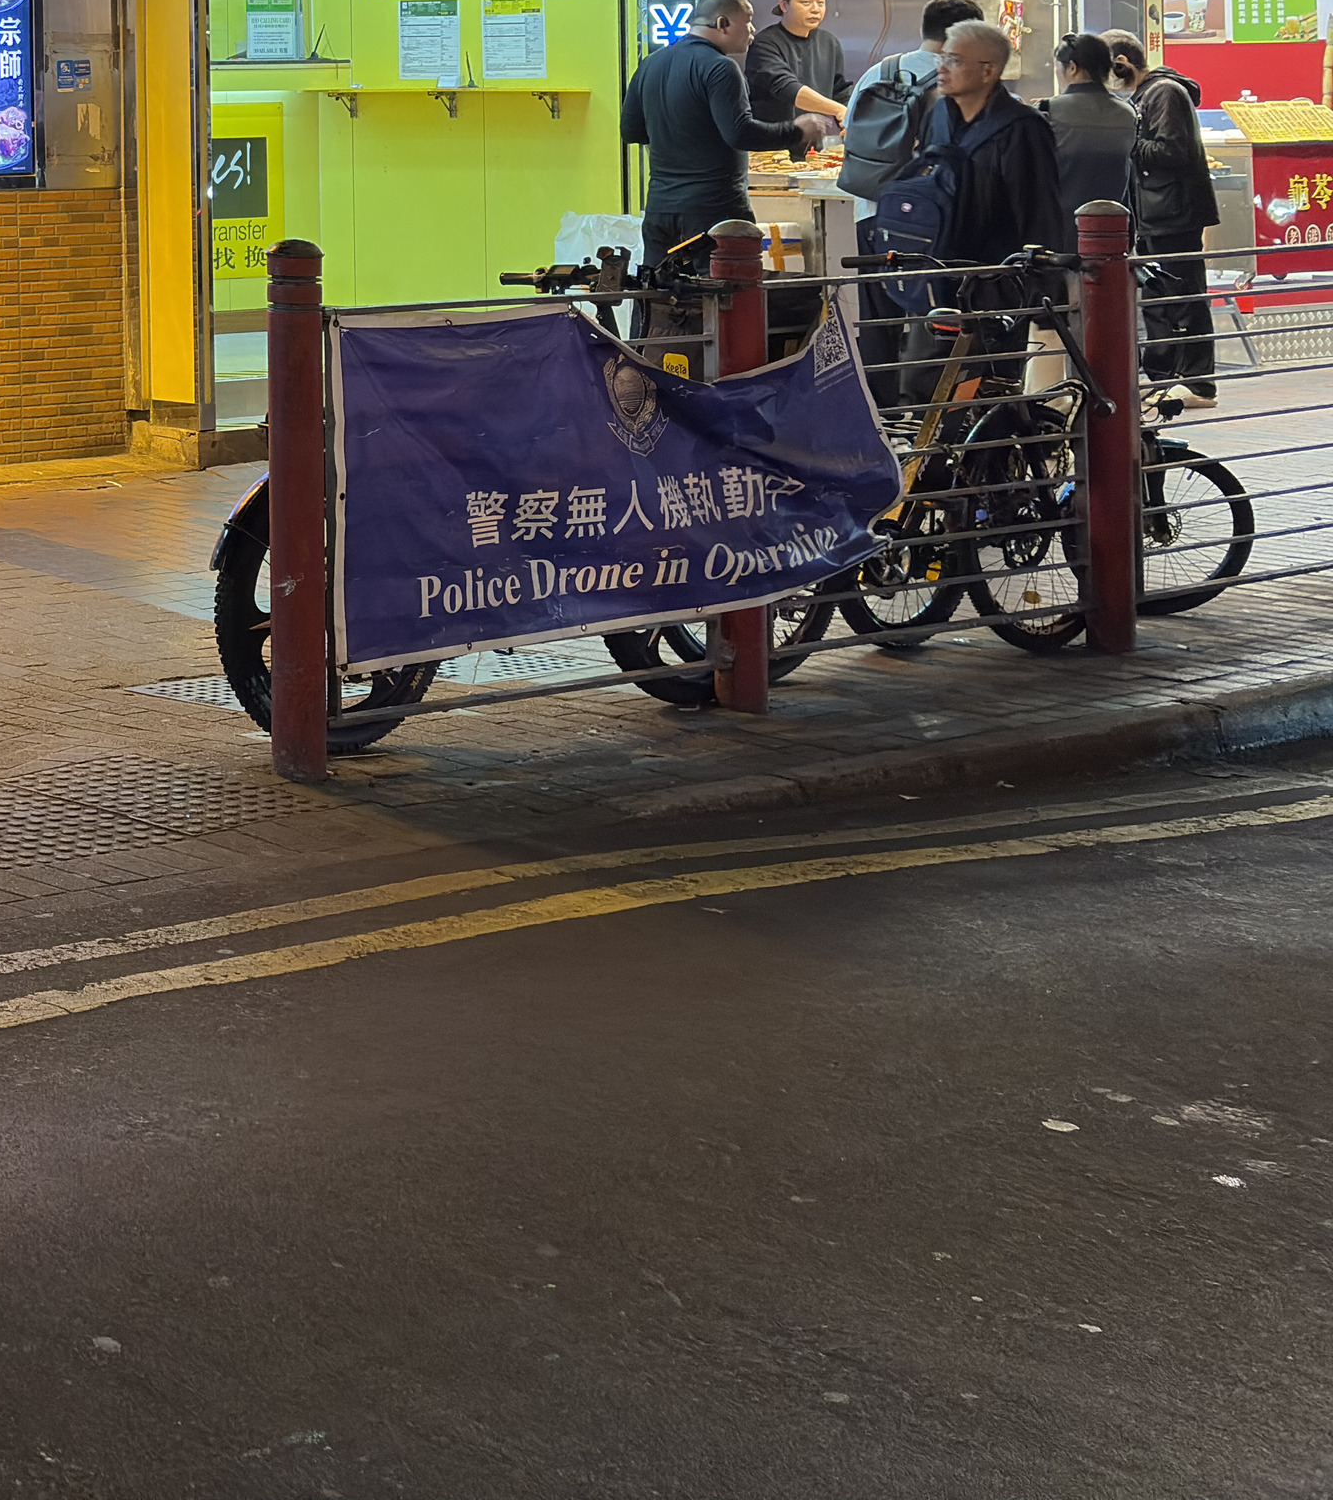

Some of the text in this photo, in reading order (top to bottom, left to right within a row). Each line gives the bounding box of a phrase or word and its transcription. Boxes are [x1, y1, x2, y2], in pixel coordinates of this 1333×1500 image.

[211, 141, 252, 190] es!
[213, 219, 268, 242] ransfer
[213, 246, 268, 270] 找換
[417, 571, 525, 620] Police
[531, 558, 645, 602] Drone
[653, 548, 689, 587] in
